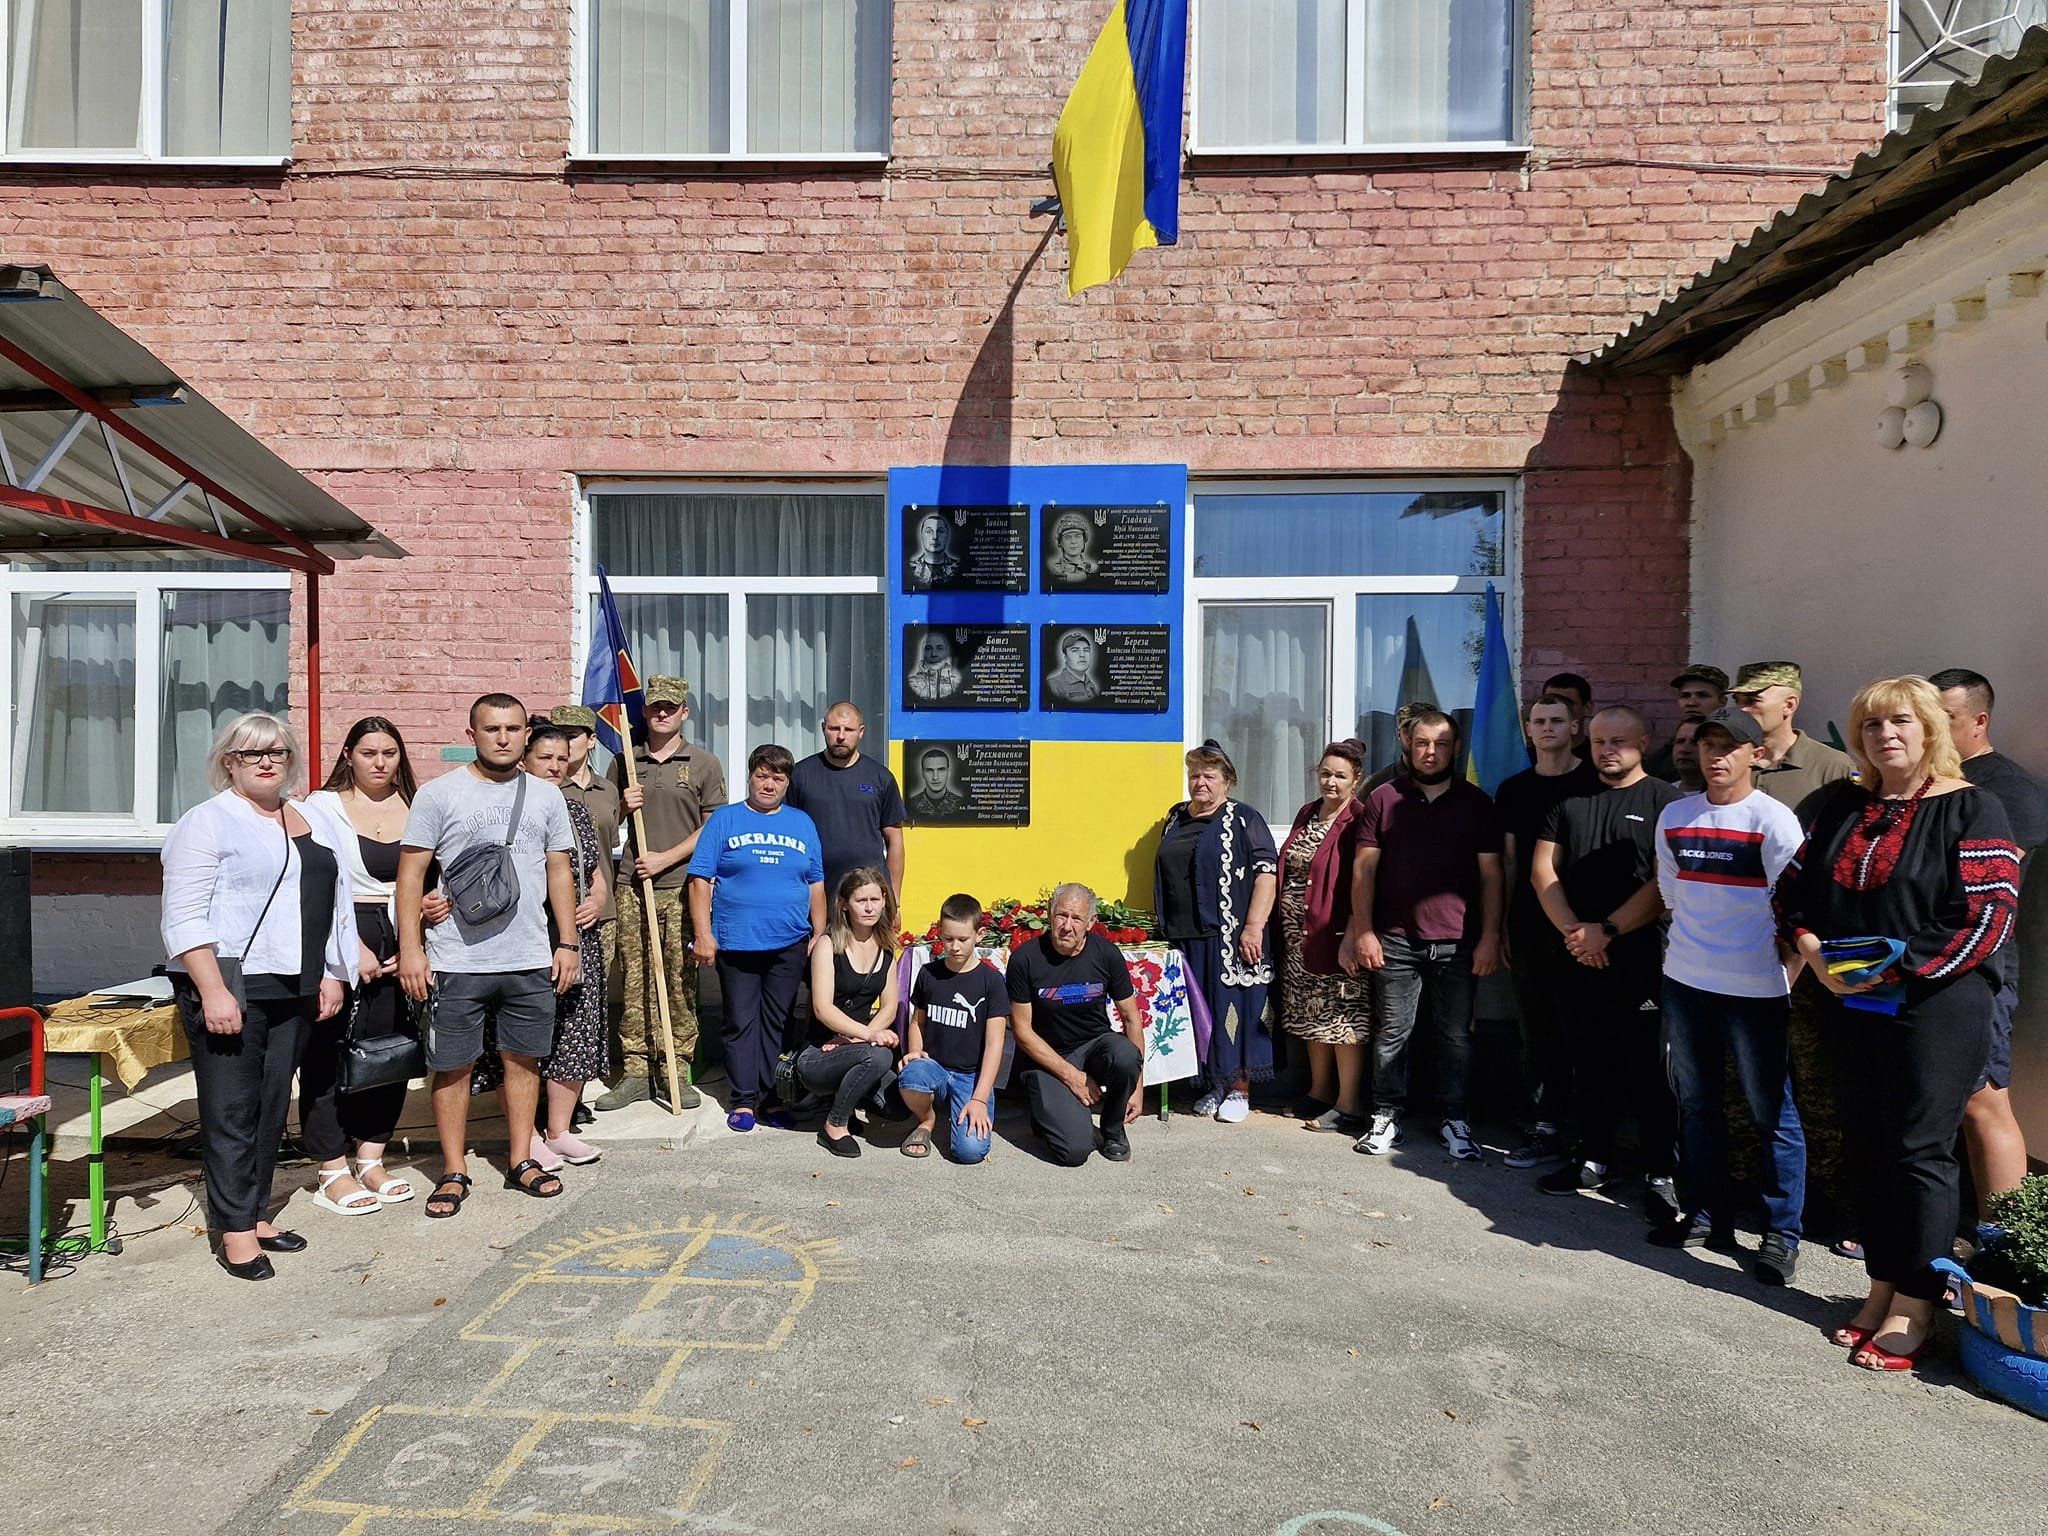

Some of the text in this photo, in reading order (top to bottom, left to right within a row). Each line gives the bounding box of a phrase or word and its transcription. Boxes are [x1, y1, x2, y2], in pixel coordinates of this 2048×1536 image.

[1121, 515, 1152, 525] Гладкий
[986, 635, 1009, 645] Ботез
[1124, 637, 1149, 649] Береза
[976, 749, 1022, 761] Трехманенко
[461, 805, 540, 843] LOS ANGLES
[728, 832, 806, 855] UKRAINE
[760, 856, 779, 865] 1991
[685, 1293, 771, 1333] 10
[383, 1431, 471, 1490] 6
